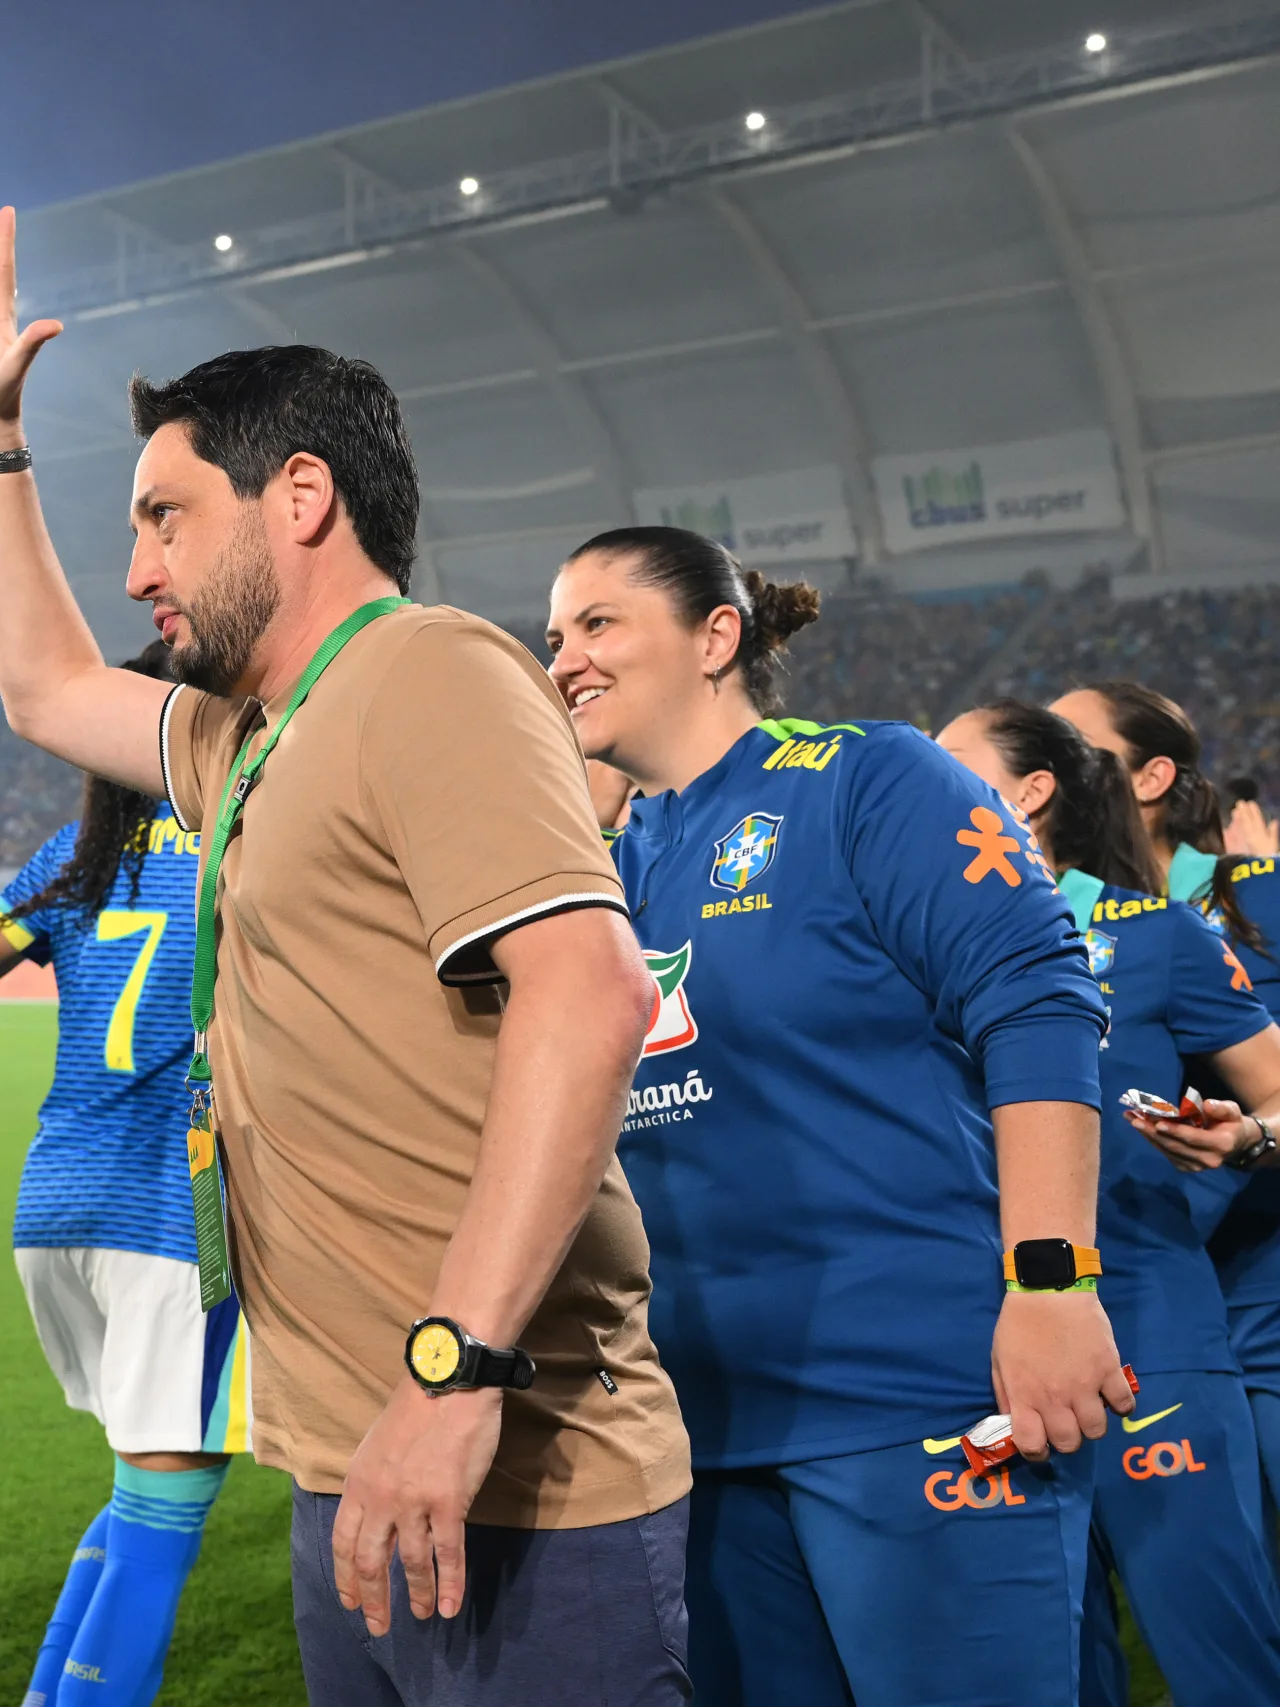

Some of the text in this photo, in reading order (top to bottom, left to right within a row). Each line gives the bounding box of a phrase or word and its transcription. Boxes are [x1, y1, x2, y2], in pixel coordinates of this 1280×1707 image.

[996, 489, 1087, 522] super
[741, 521, 825, 552] super
[762, 735, 843, 771] Itaú
[734, 844, 759, 859] CBF
[701, 893, 772, 919] BRASIL
[96, 911, 169, 1071] 7
[599, 1370, 614, 1389] BOSS
[1122, 1439, 1206, 1480] GOL
[924, 1466, 1026, 1512] GOL
